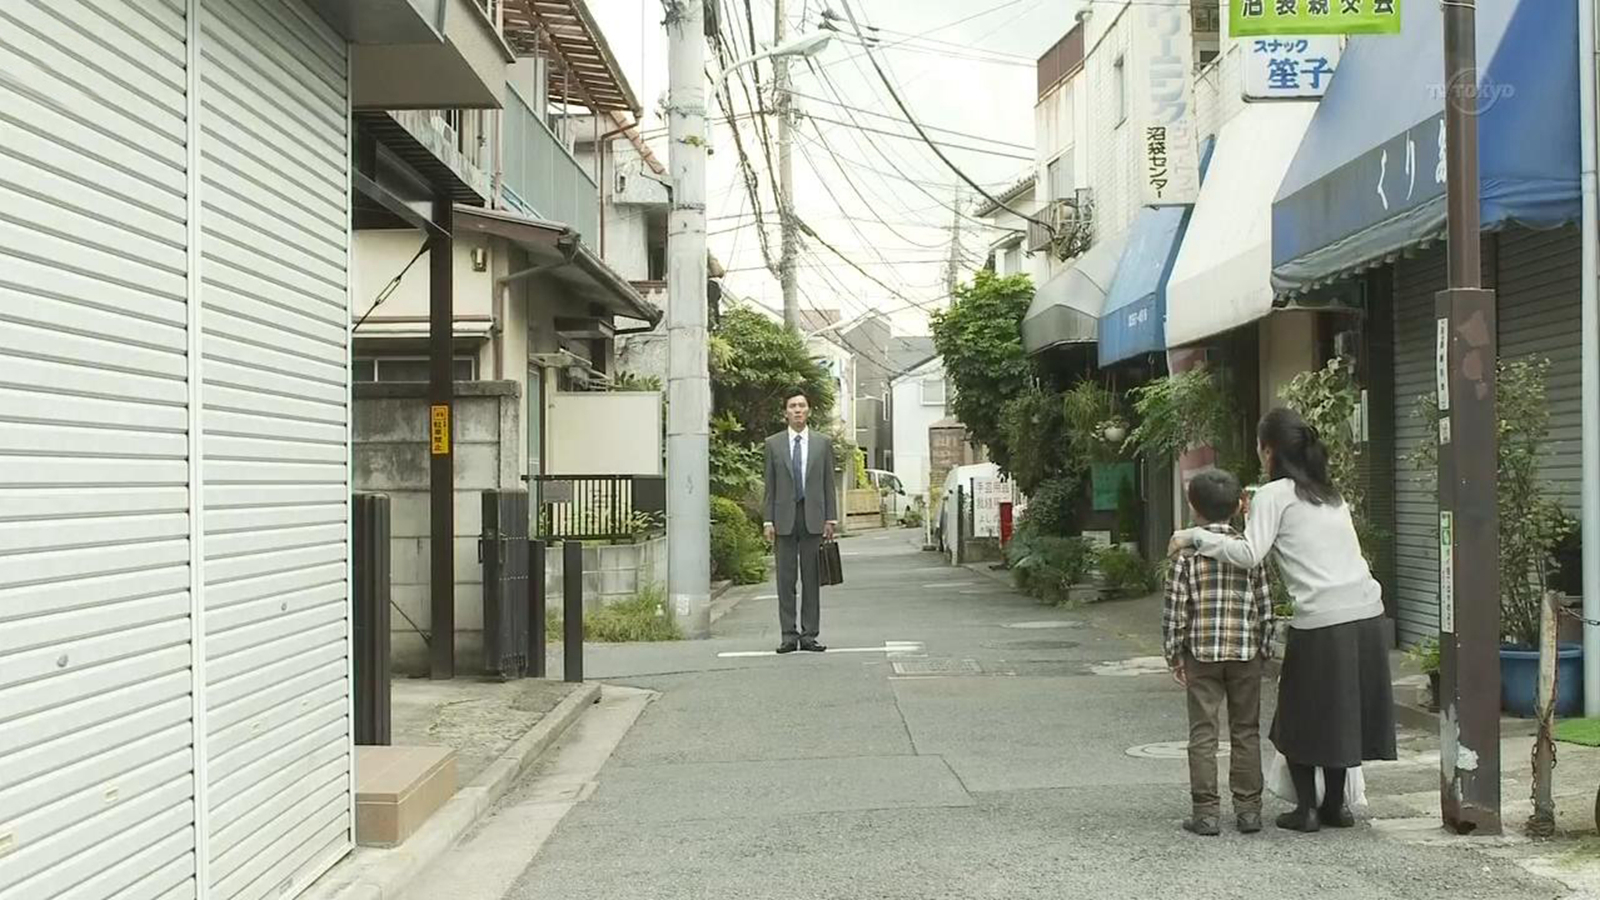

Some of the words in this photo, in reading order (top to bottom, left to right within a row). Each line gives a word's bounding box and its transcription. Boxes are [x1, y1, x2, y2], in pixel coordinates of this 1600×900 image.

[1253, 39, 1309, 53] スナック
[1147, 126, 1168, 199] 沼袋センター
